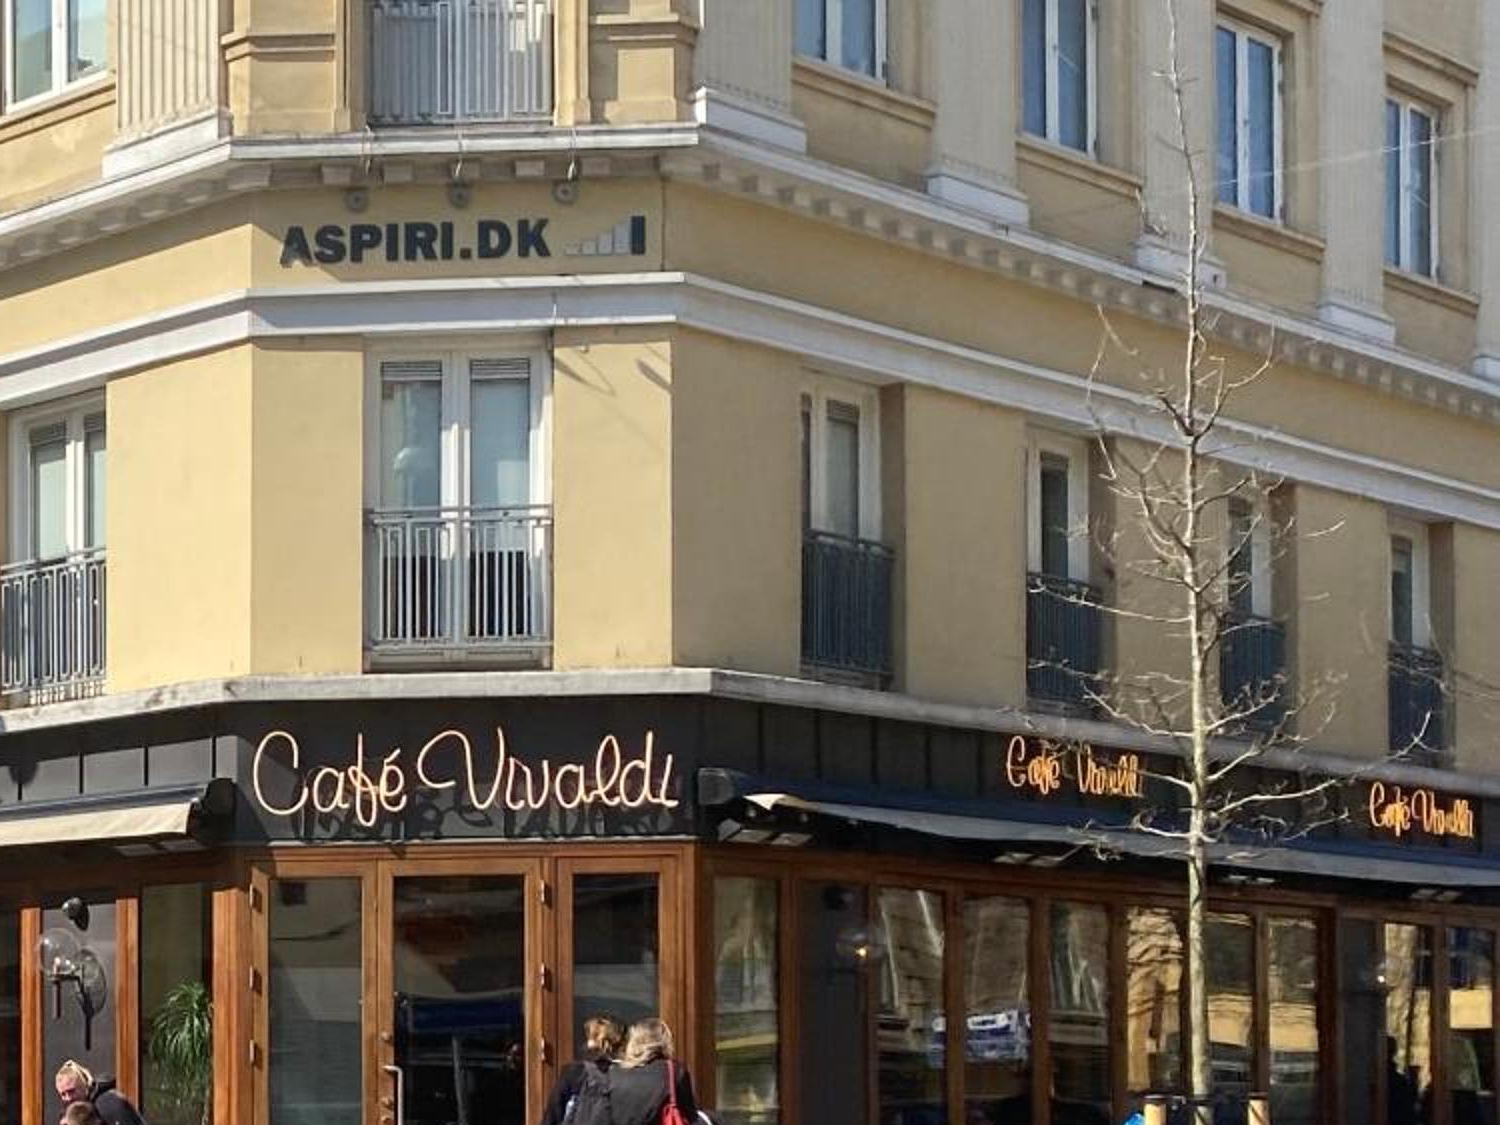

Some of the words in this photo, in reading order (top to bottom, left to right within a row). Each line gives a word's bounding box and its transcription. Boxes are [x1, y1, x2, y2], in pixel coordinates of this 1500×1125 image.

[280, 217, 551, 269] ASPIRI.DK
[253, 730, 408, 827] Café
[417, 726, 678, 812] Vivaldi
[1369, 781, 1411, 837] Café
